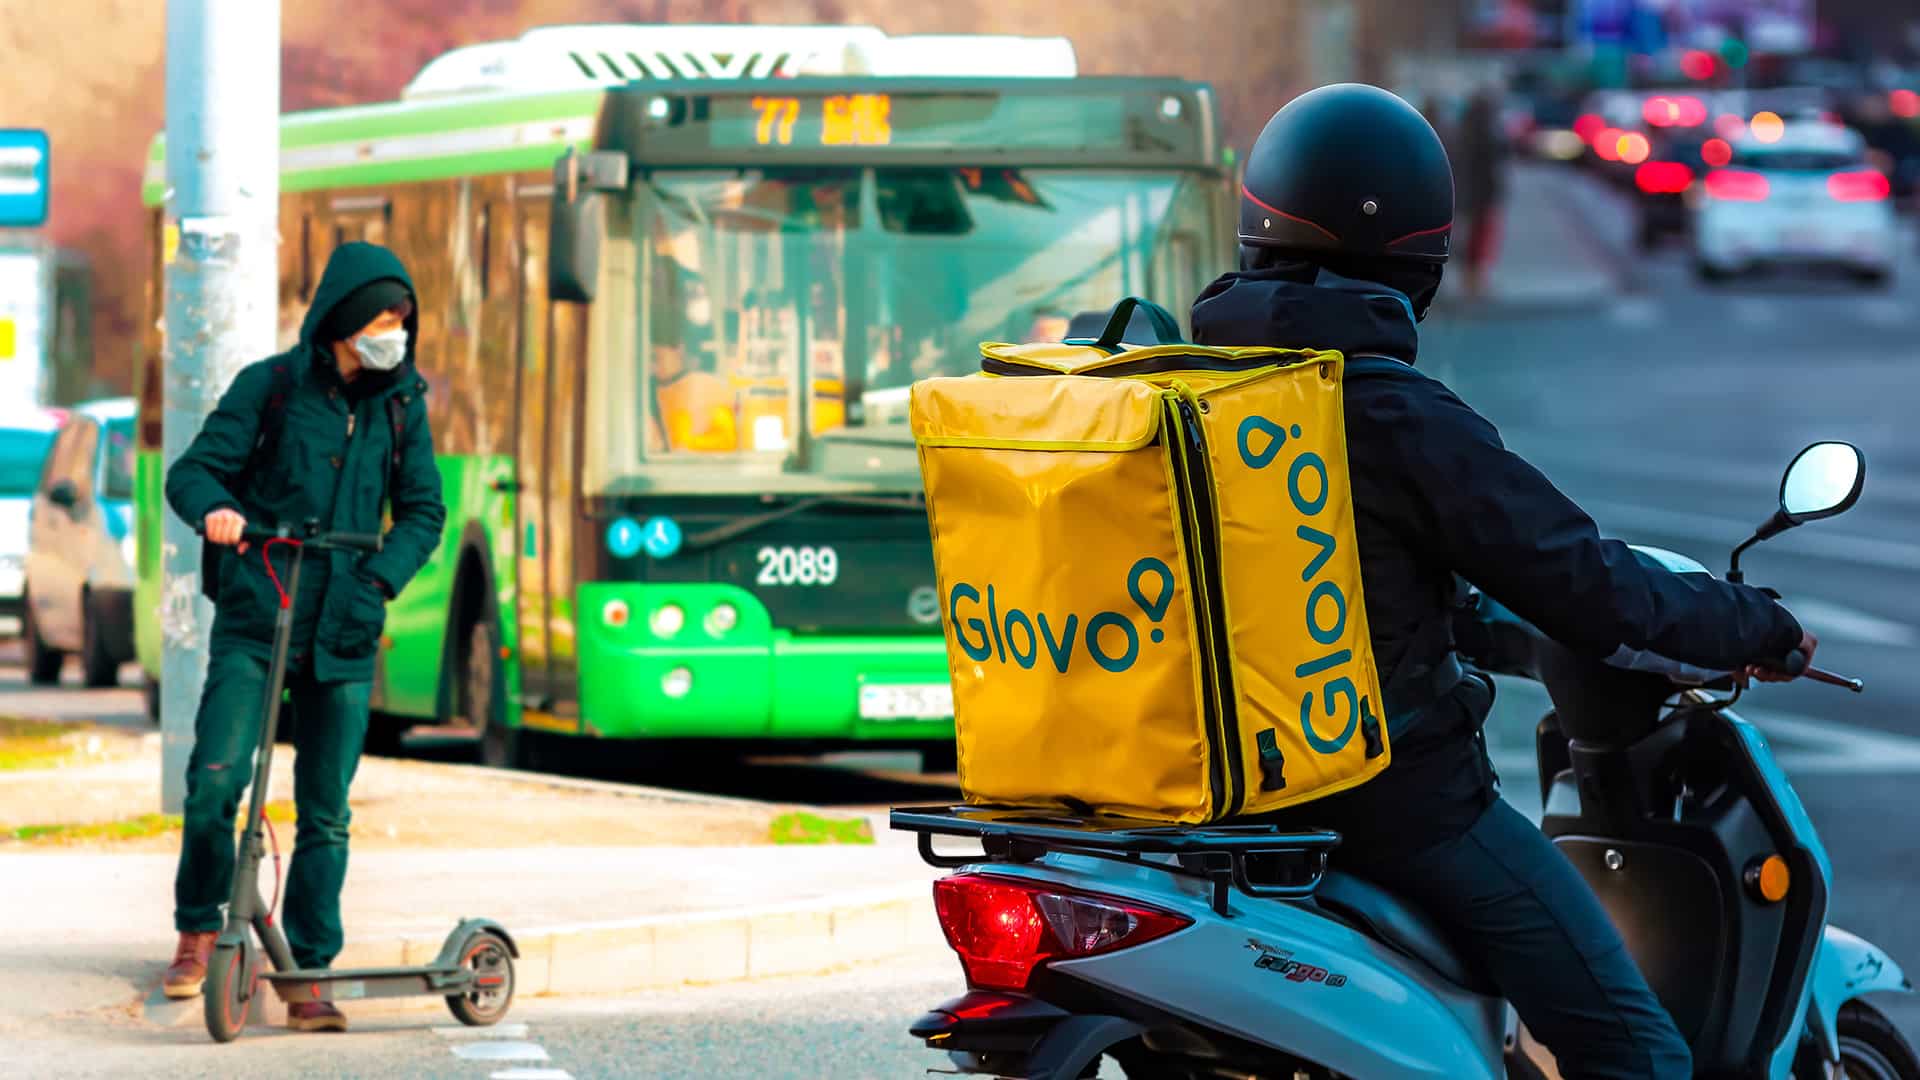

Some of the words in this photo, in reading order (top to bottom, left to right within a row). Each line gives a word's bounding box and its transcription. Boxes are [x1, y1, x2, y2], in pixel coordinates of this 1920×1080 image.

[752, 96, 800, 144] 77
[757, 546, 838, 585] 2089
[949, 583, 1139, 673] Glovo
[1289, 453, 1360, 754] Glovo
